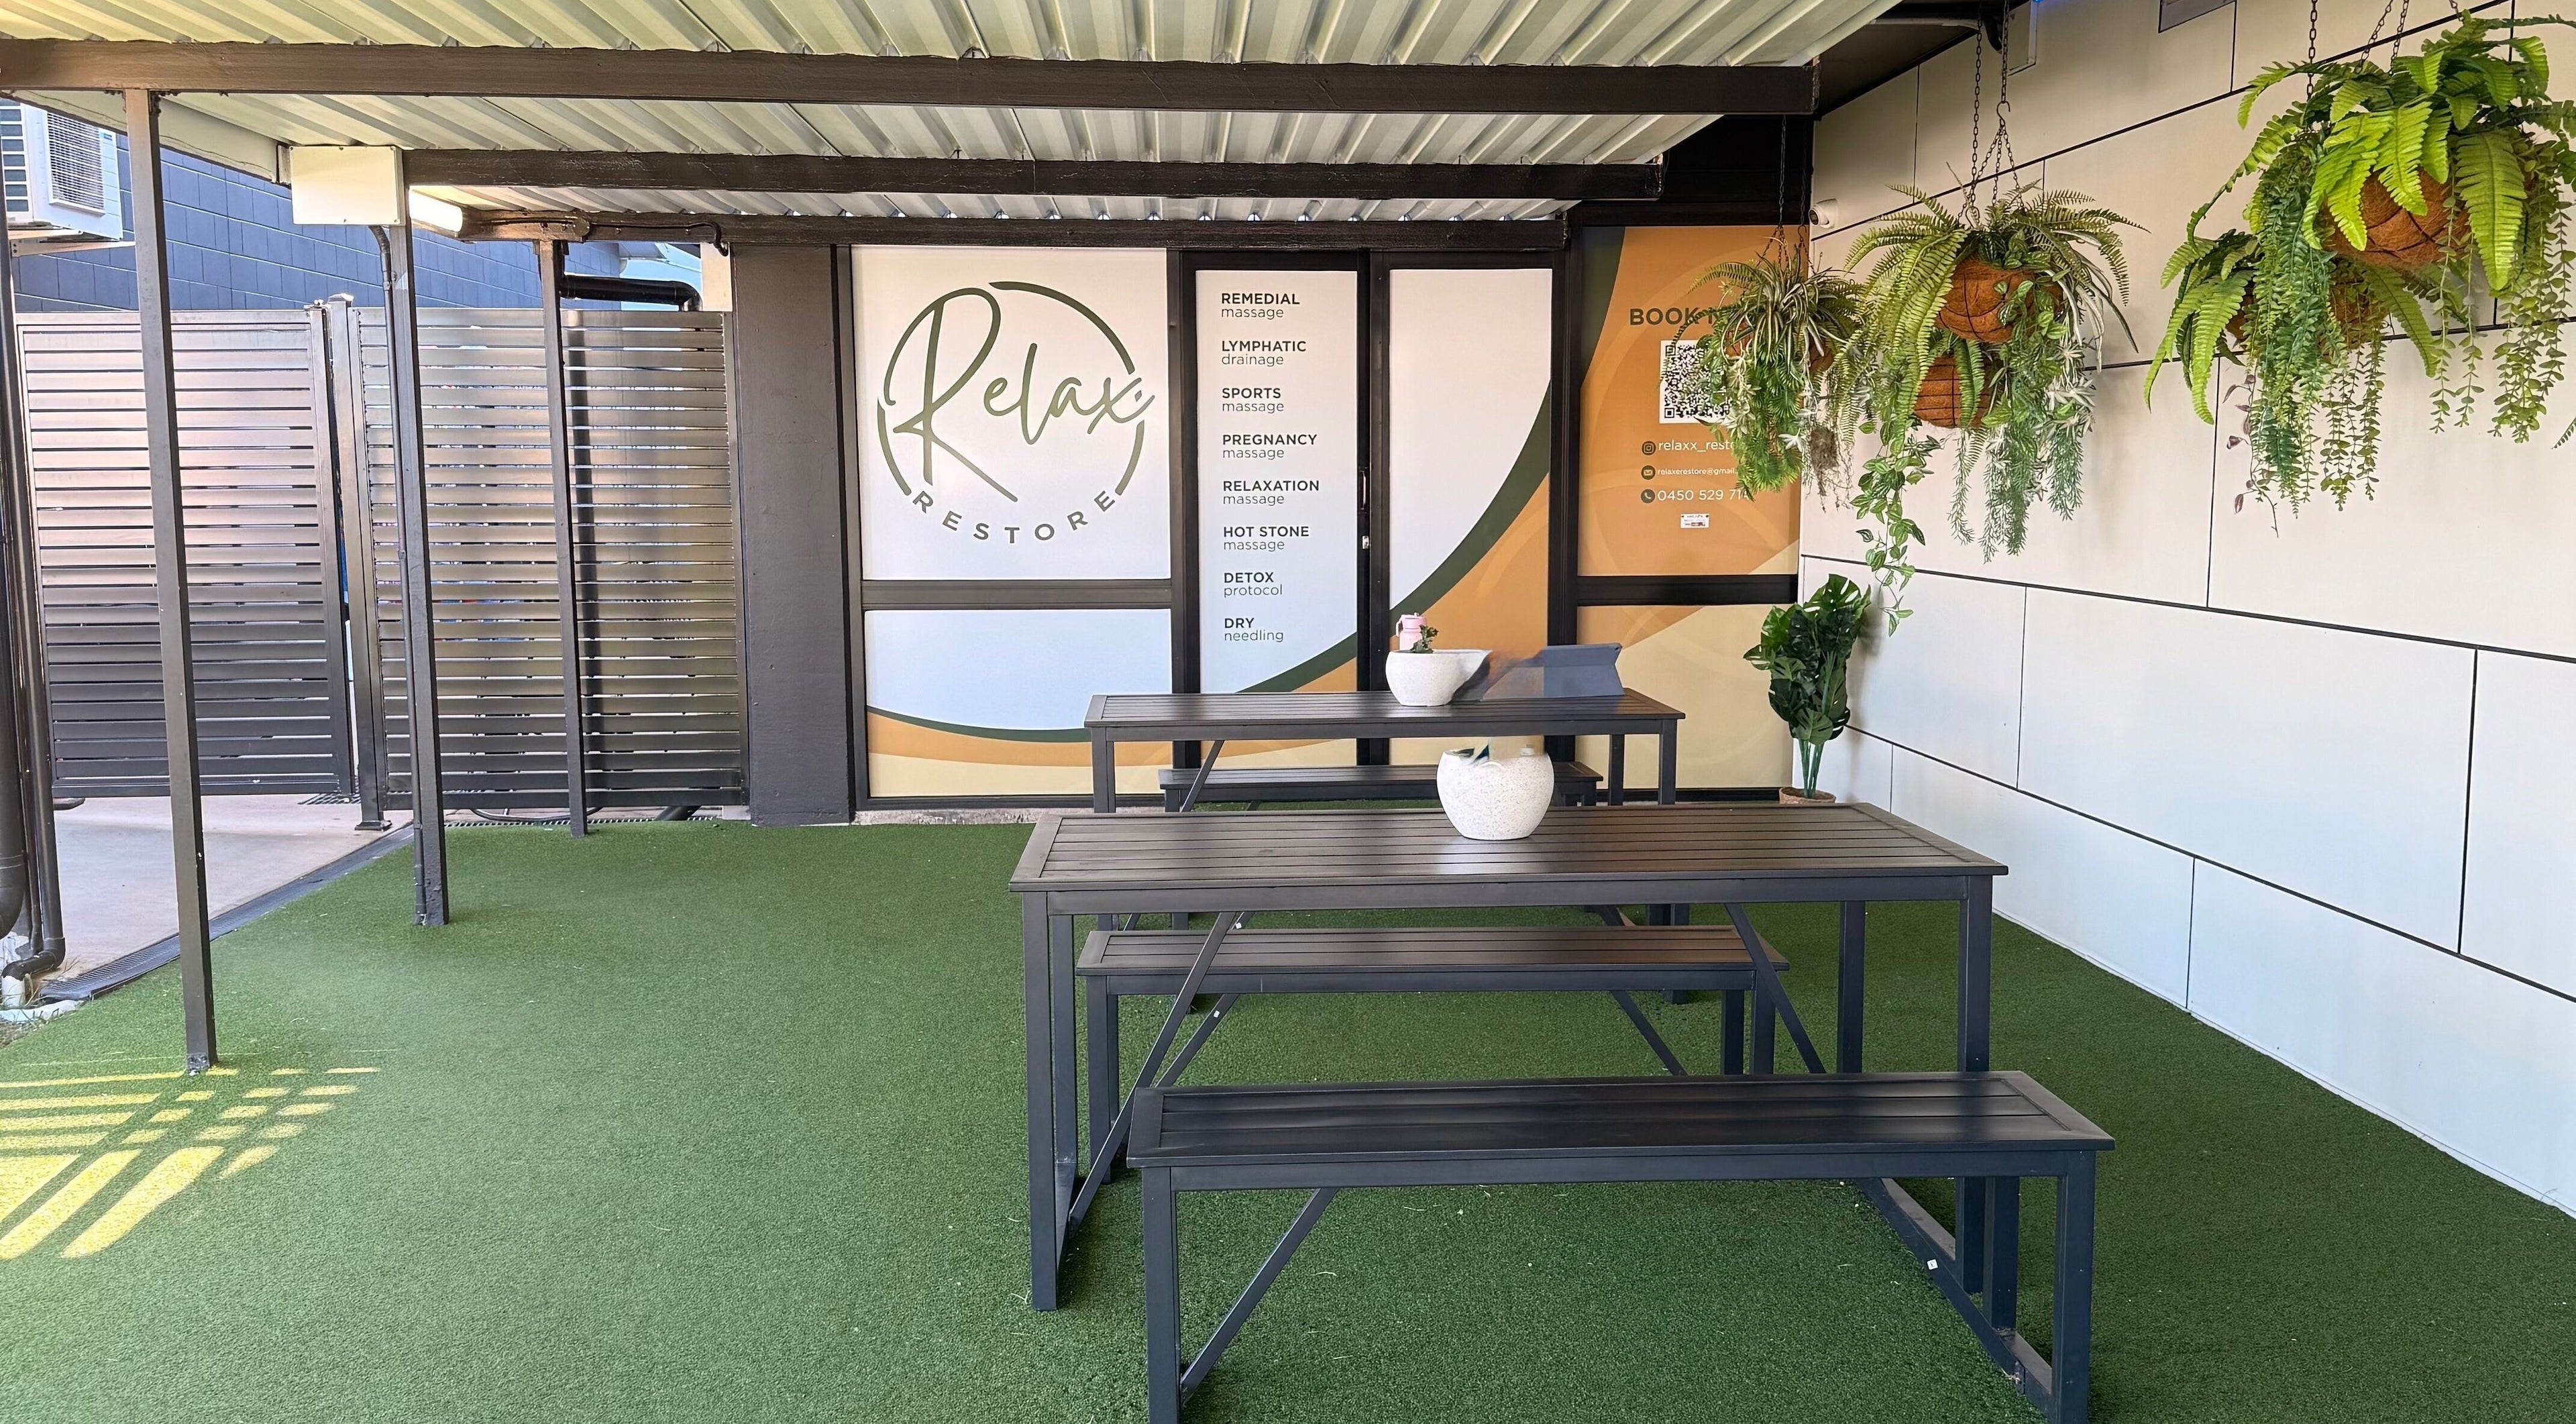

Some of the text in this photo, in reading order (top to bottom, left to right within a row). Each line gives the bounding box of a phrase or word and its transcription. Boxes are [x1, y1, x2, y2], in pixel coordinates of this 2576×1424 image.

[1221, 292, 1301, 305] REMEDIAL
[1221, 308, 1285, 321] massage
[1629, 307, 1700, 325] BOOK
[1222, 339, 1307, 352] LYMPHATIC
[1221, 353, 1285, 368] drainage
[883, 287, 1156, 502] Relax
[1222, 387, 1282, 399] SPORTS
[1222, 402, 1285, 415] massage
[1222, 433, 1318, 446] PREGNANCY
[1222, 449, 1285, 461] massage
[1658, 468, 1738, 476] relaxerestore@gmail.
[1223, 480, 1320, 492] RELAXATION
[1223, 495, 1285, 506] massage
[1657, 490, 1695, 501] 0450
[1699, 490, 1724, 500] 529
[912, 490, 1116, 544] RESTORE
[1223, 525, 1310, 538] HOT STONE
[1223, 541, 1285, 552] massage
[1224, 571, 1275, 584] DETOX
[1224, 584, 1283, 598] protocol
[1224, 617, 1255, 629] DRY
[1224, 629, 1284, 643] needling
